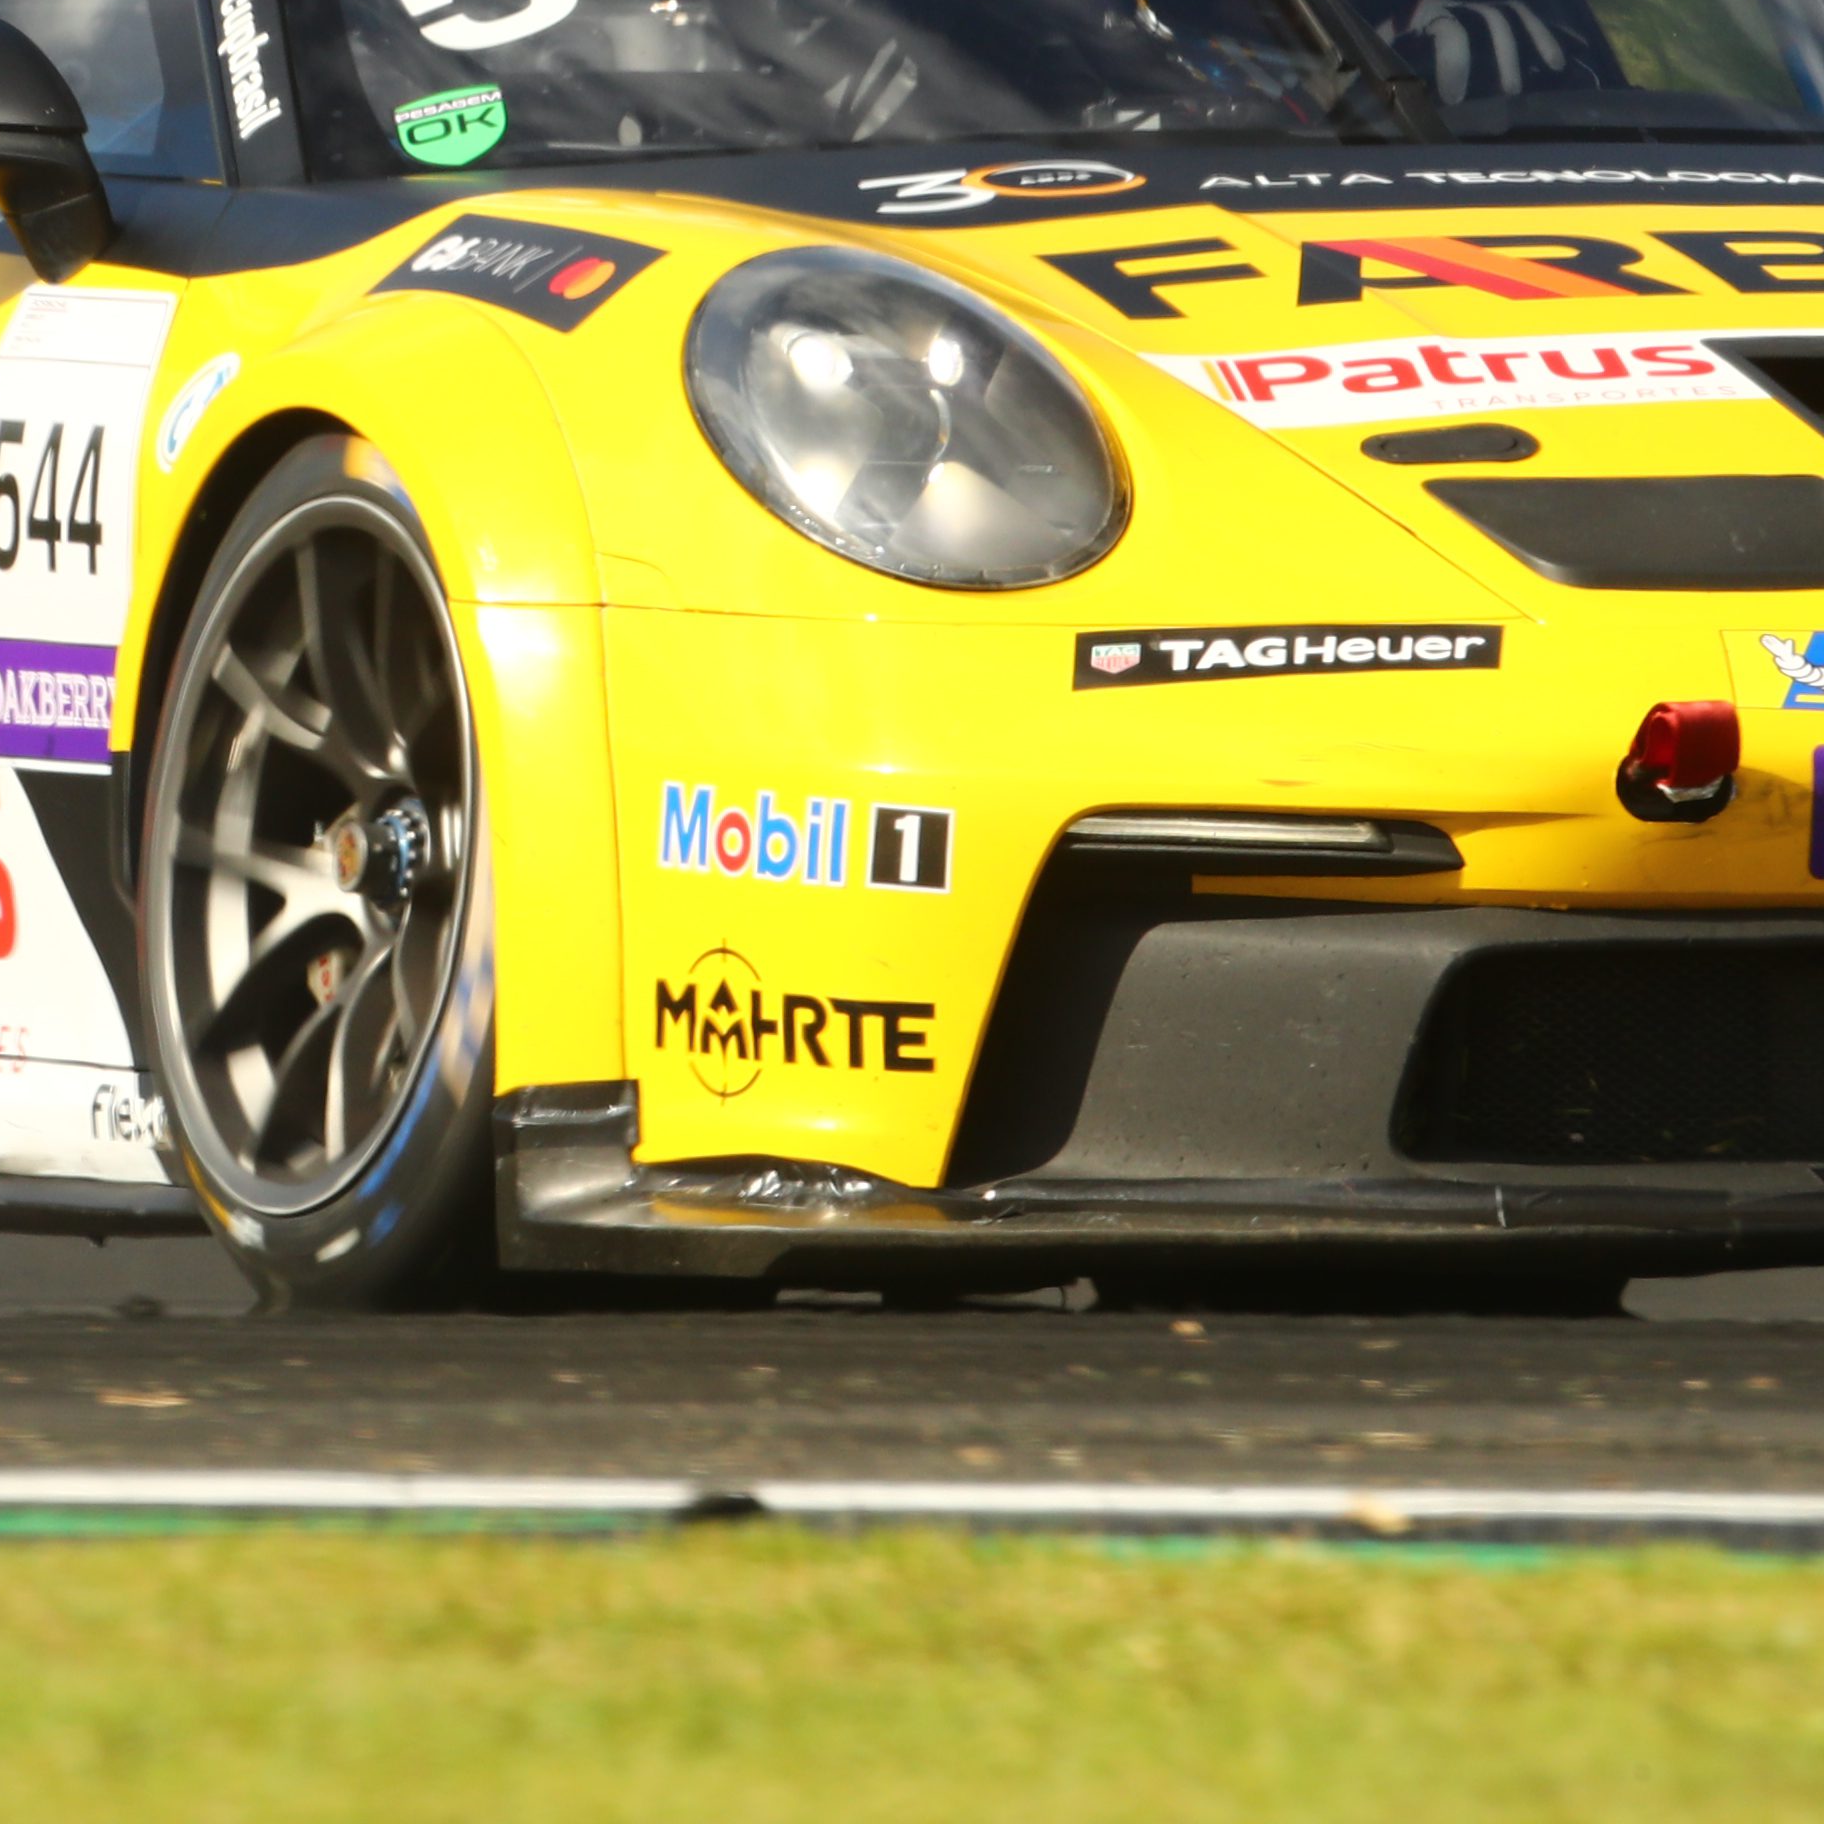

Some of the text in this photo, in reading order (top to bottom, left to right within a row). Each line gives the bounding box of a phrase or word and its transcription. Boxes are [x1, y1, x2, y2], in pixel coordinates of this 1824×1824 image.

[406, 105, 498, 146] OK
[1199, 172, 1395, 190] ALTA
[1234, 344, 1717, 404] Patrus
[1431, 384, 1739, 412] TRANSPORTES
[661, 782, 850, 885] Mobil
